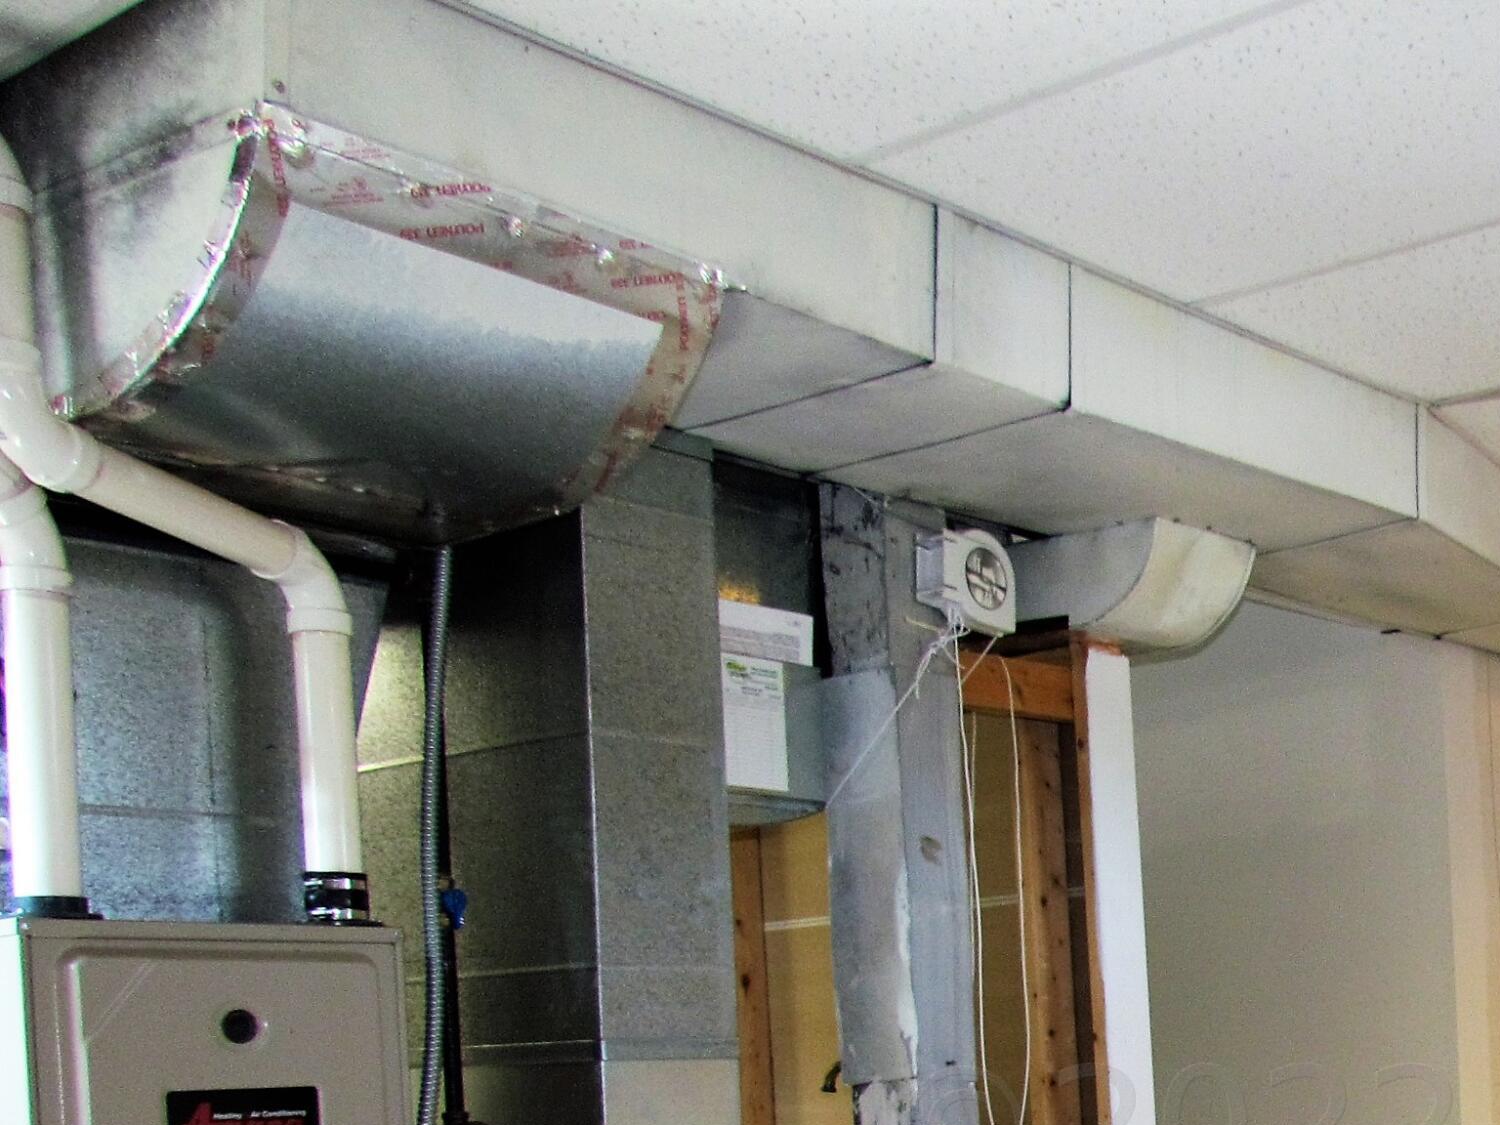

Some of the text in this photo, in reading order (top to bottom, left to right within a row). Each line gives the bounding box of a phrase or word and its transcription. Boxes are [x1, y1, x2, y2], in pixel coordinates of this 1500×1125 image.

[212, 1109, 307, 1120] Heating Air Conditioning
